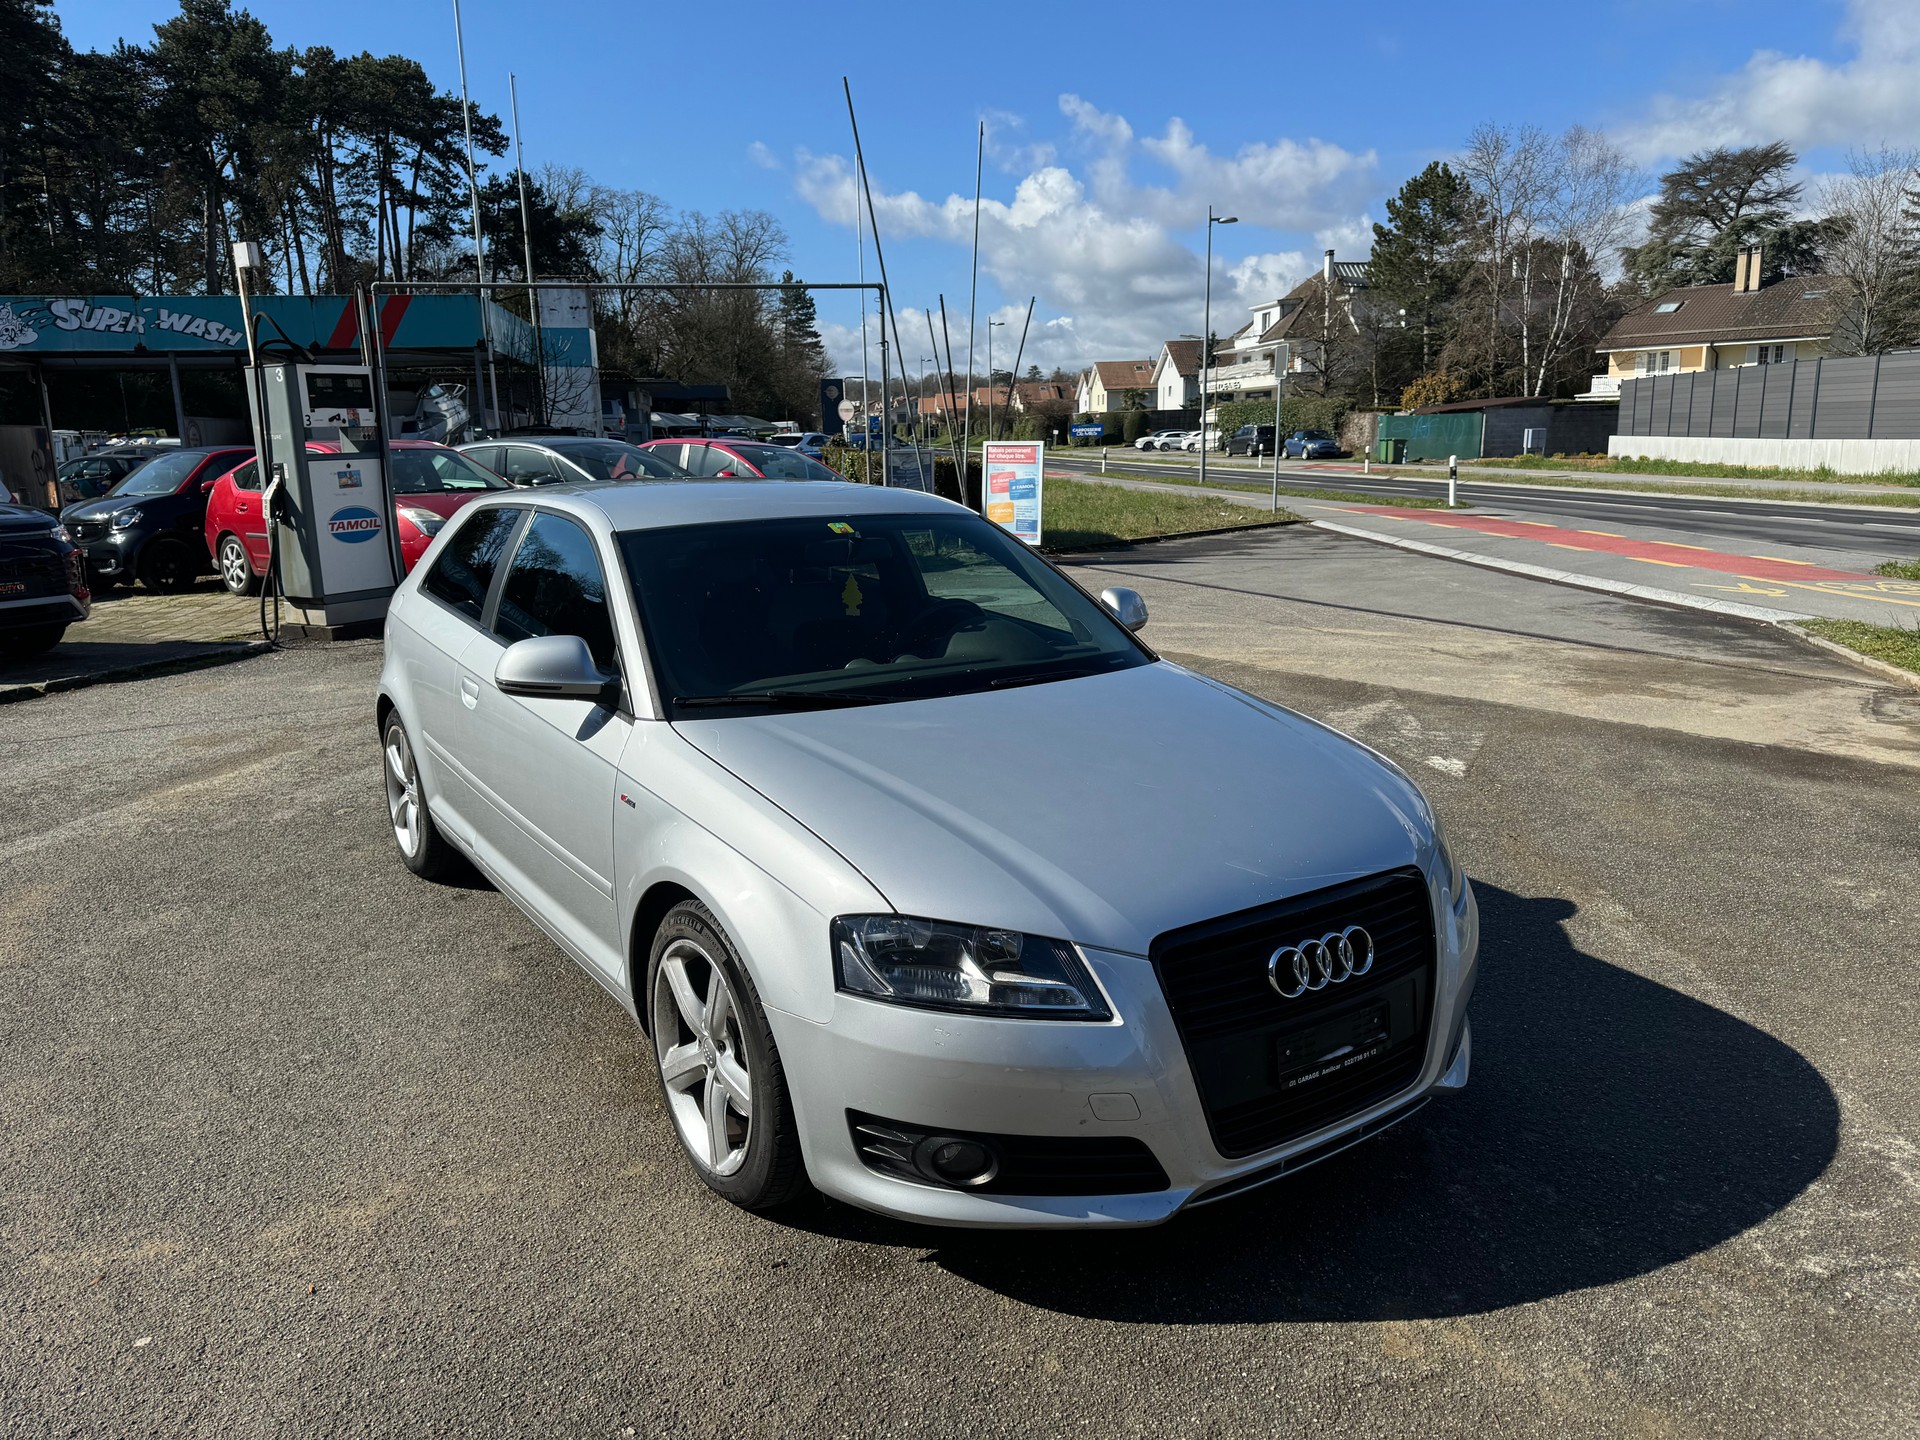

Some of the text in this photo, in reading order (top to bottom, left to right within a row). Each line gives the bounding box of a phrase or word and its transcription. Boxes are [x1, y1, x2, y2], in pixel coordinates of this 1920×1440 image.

[50, 299, 244, 347] SUPER WASH
[275, 367, 284, 382] 3
[304, 414, 312, 427] 3
[328, 518, 382, 532] TAMOIL
[669, 915, 703, 933] MICHELIN
[1297, 1071, 1320, 1084] GARAGE
